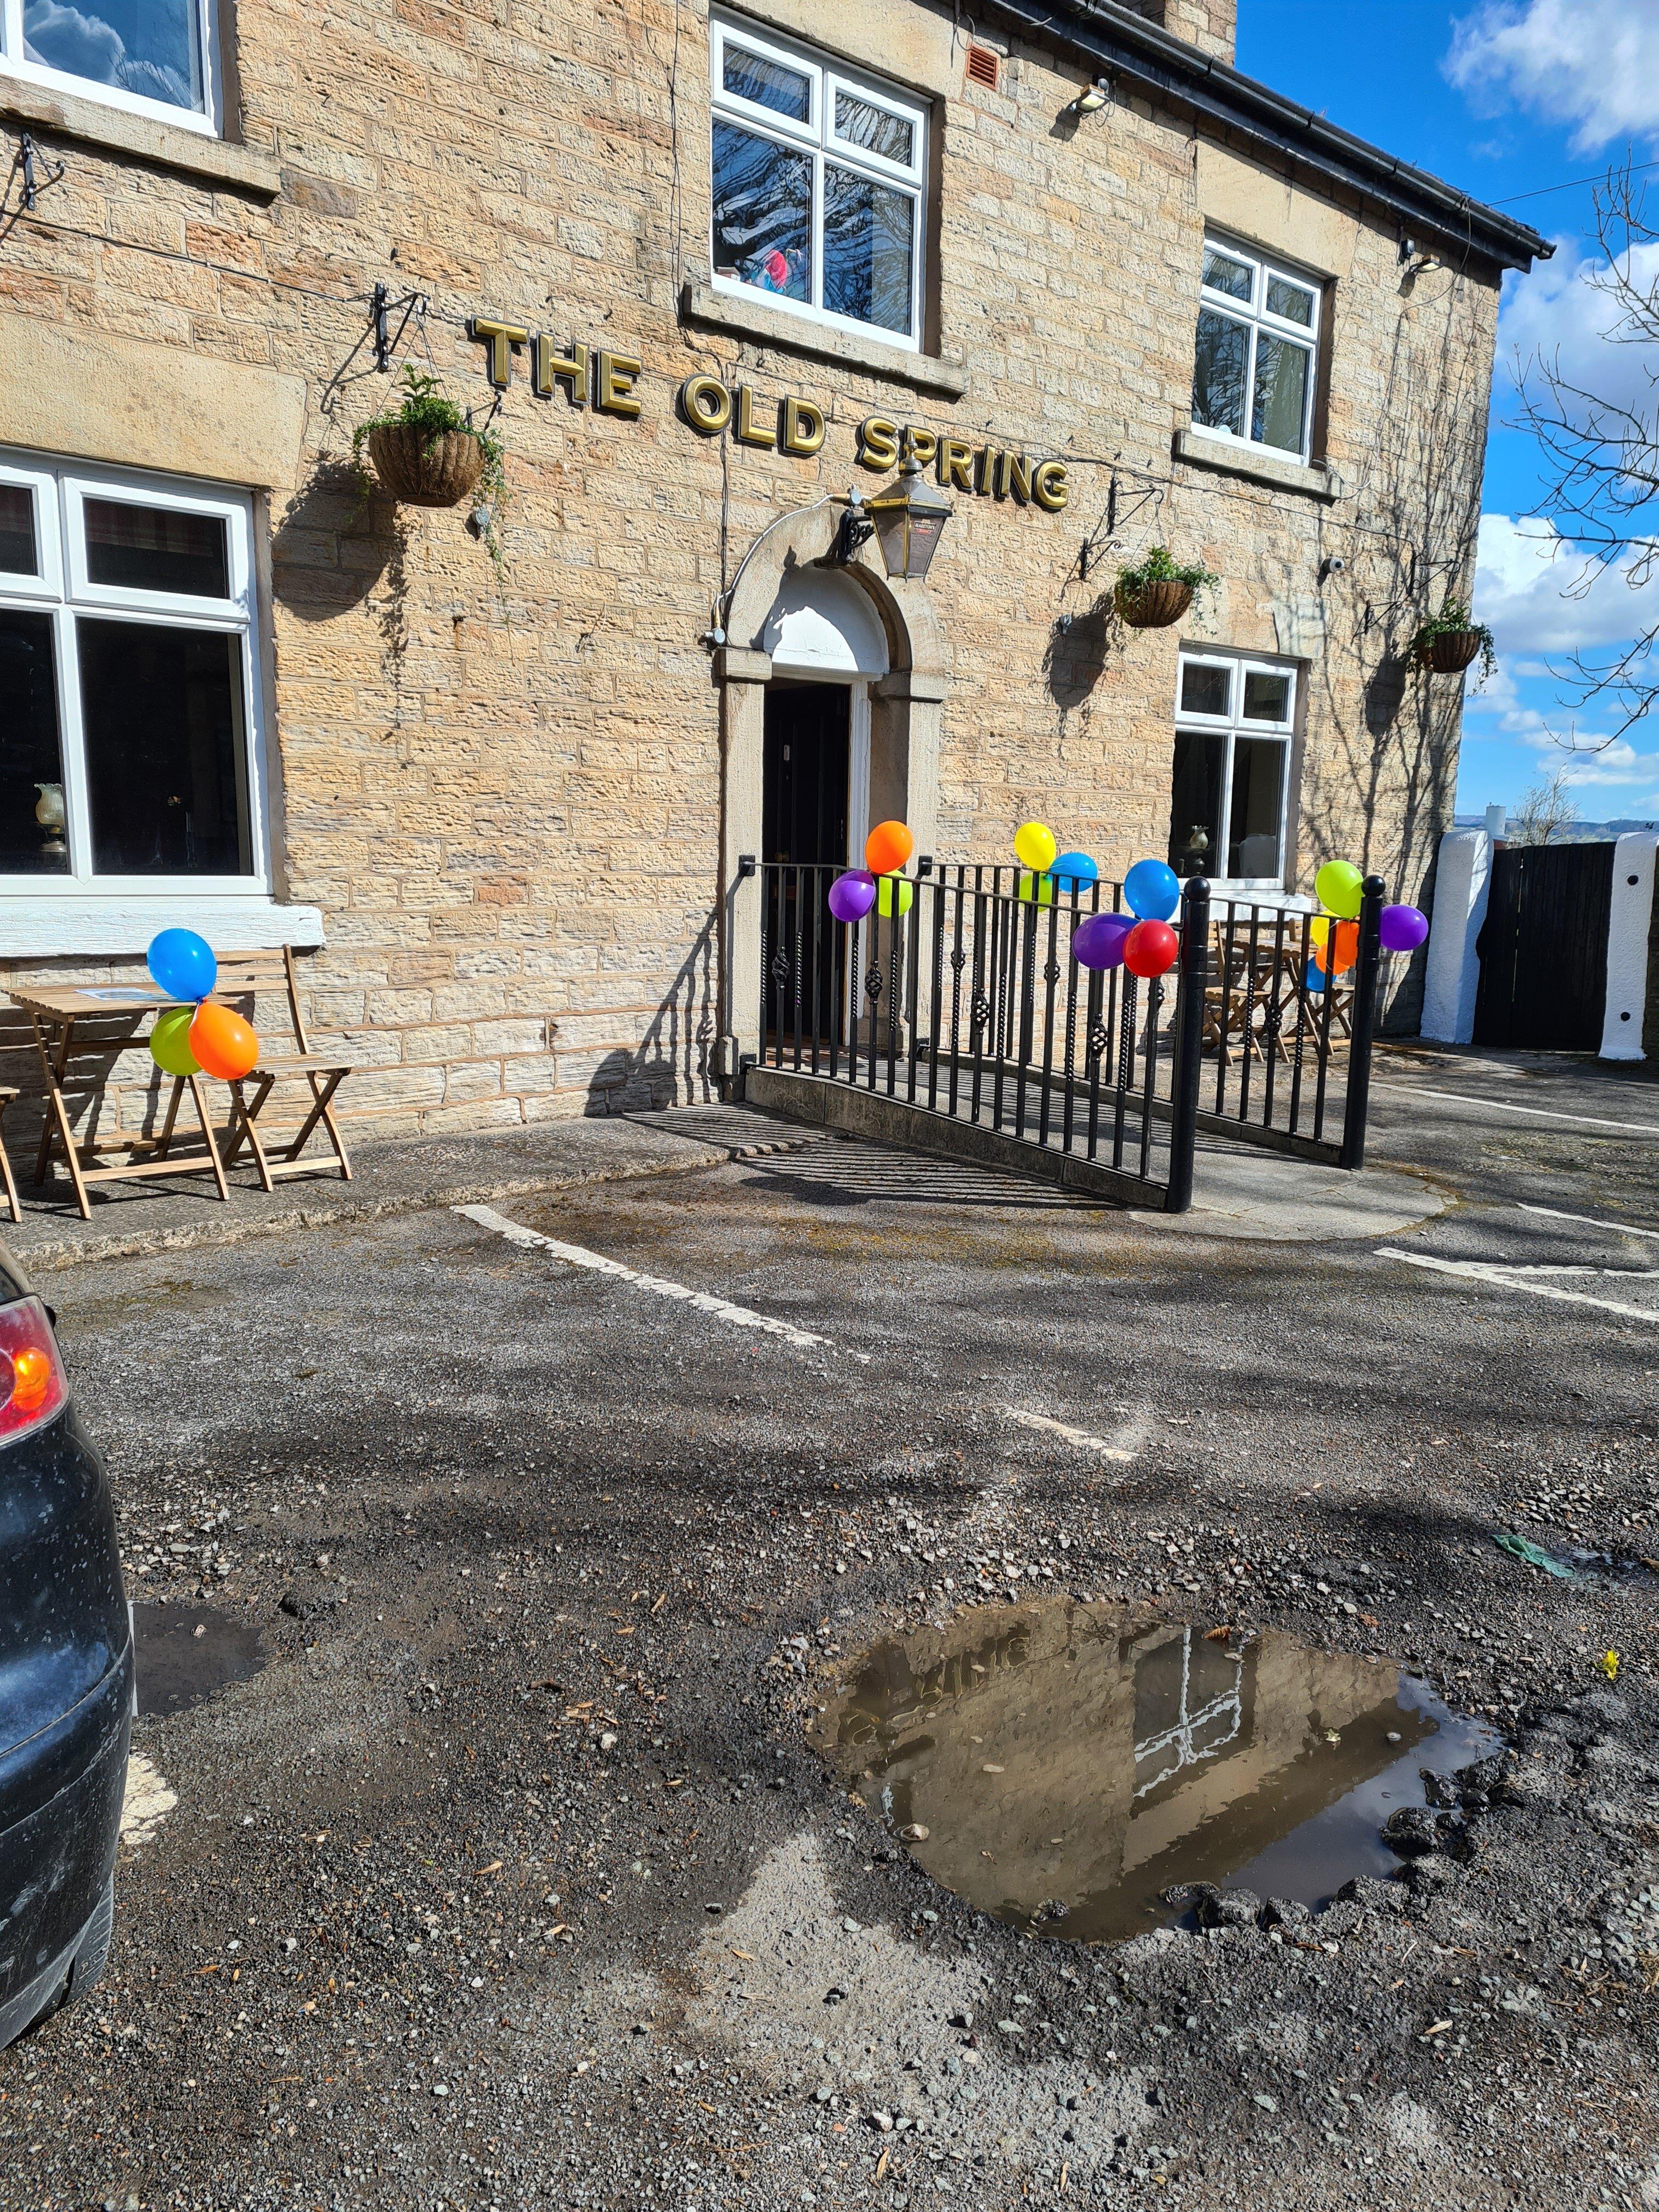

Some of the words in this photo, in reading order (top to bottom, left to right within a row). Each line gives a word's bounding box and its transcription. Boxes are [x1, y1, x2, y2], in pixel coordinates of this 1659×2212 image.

[472, 315, 642, 415] THE
[684, 374, 825, 454] OLD
[860, 416, 1070, 510] SPRING
